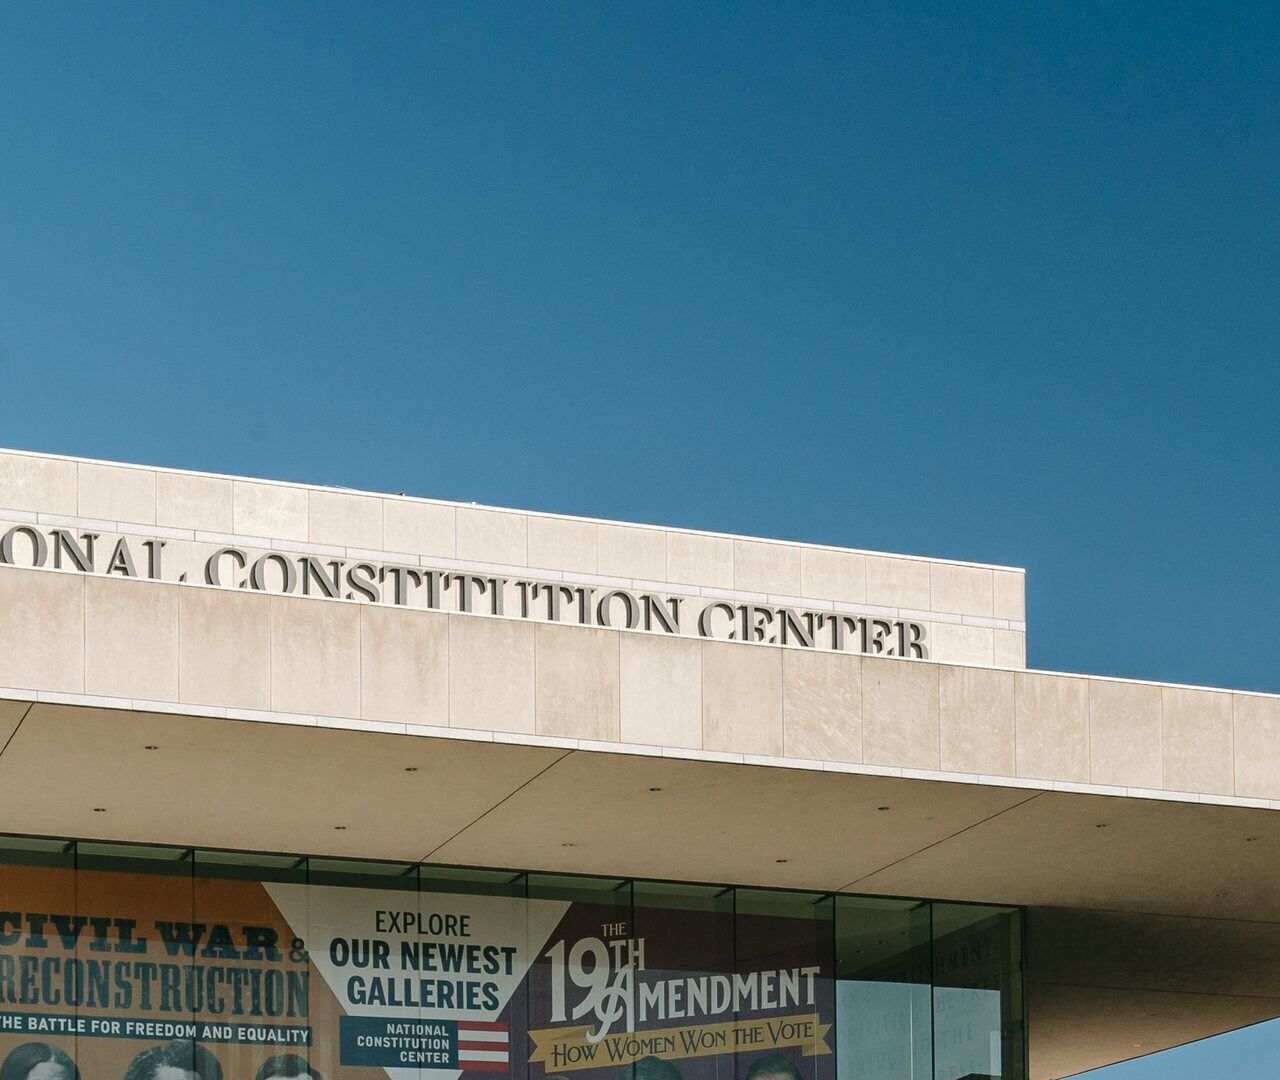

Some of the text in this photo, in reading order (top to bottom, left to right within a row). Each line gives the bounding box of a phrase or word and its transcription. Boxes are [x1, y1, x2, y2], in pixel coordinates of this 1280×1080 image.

[204, 547, 683, 634] CONSTITUTION
[698, 601, 930, 660] CENTER
[375, 910, 471, 937] EXPLORE
[601, 922, 627, 937] THE
[154, 920, 284, 963] WAR
[288, 937, 310, 964] &
[329, 937, 517, 976] OUR NEWEST
[346, 975, 500, 1012] GALLERIES
[28, 1016, 86, 1033] BATTLE
[91, 1020, 121, 1034] FOR
[125, 1021, 197, 1038] FREEDOM
[202, 1025, 234, 1040] AND
[237, 1027, 310, 1043] EQUALITY
[356, 1035, 451, 1051] CONSTITUTION
[386, 1023, 450, 1038] NATIONAL
[399, 1051, 450, 1065] CENTER
